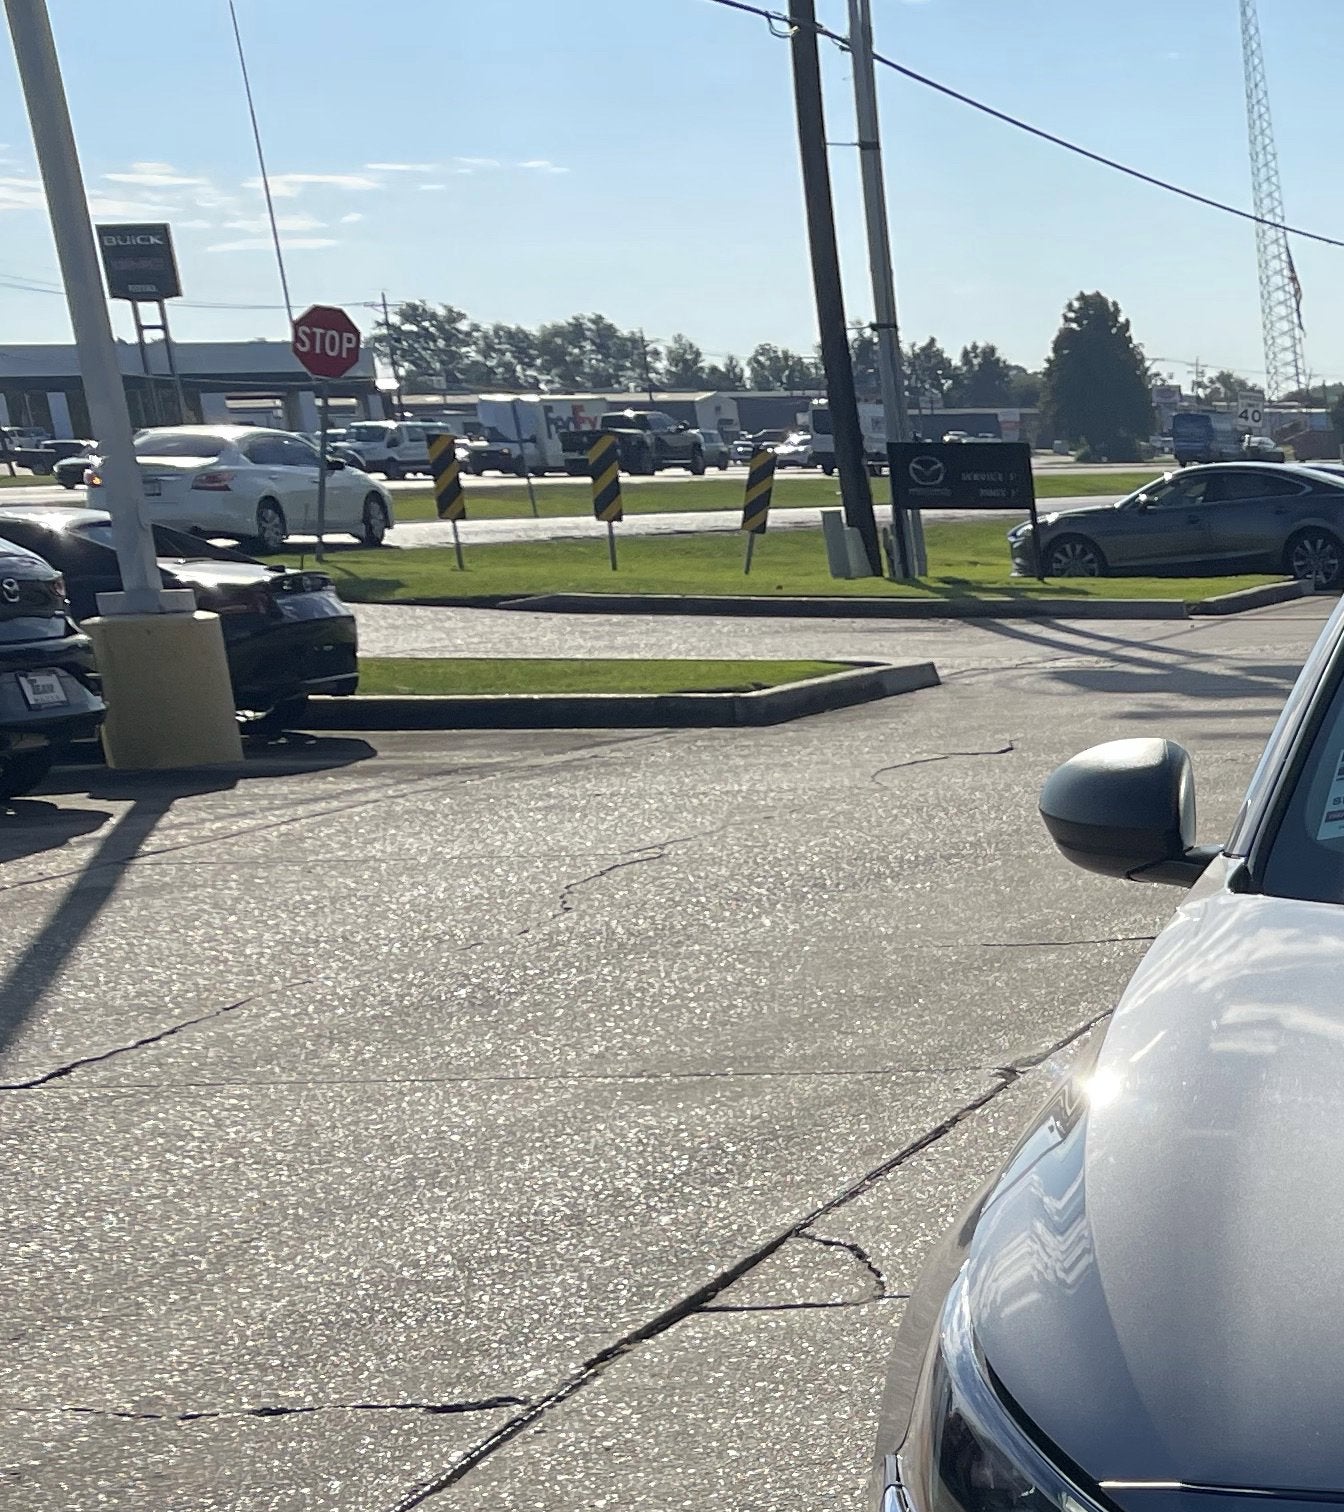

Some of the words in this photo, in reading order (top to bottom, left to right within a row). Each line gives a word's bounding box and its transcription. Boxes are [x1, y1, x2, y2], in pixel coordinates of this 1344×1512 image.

[103, 234, 164, 246] BUICK
[295, 326, 357, 358] STOP
[1238, 409, 1262, 423] 40
